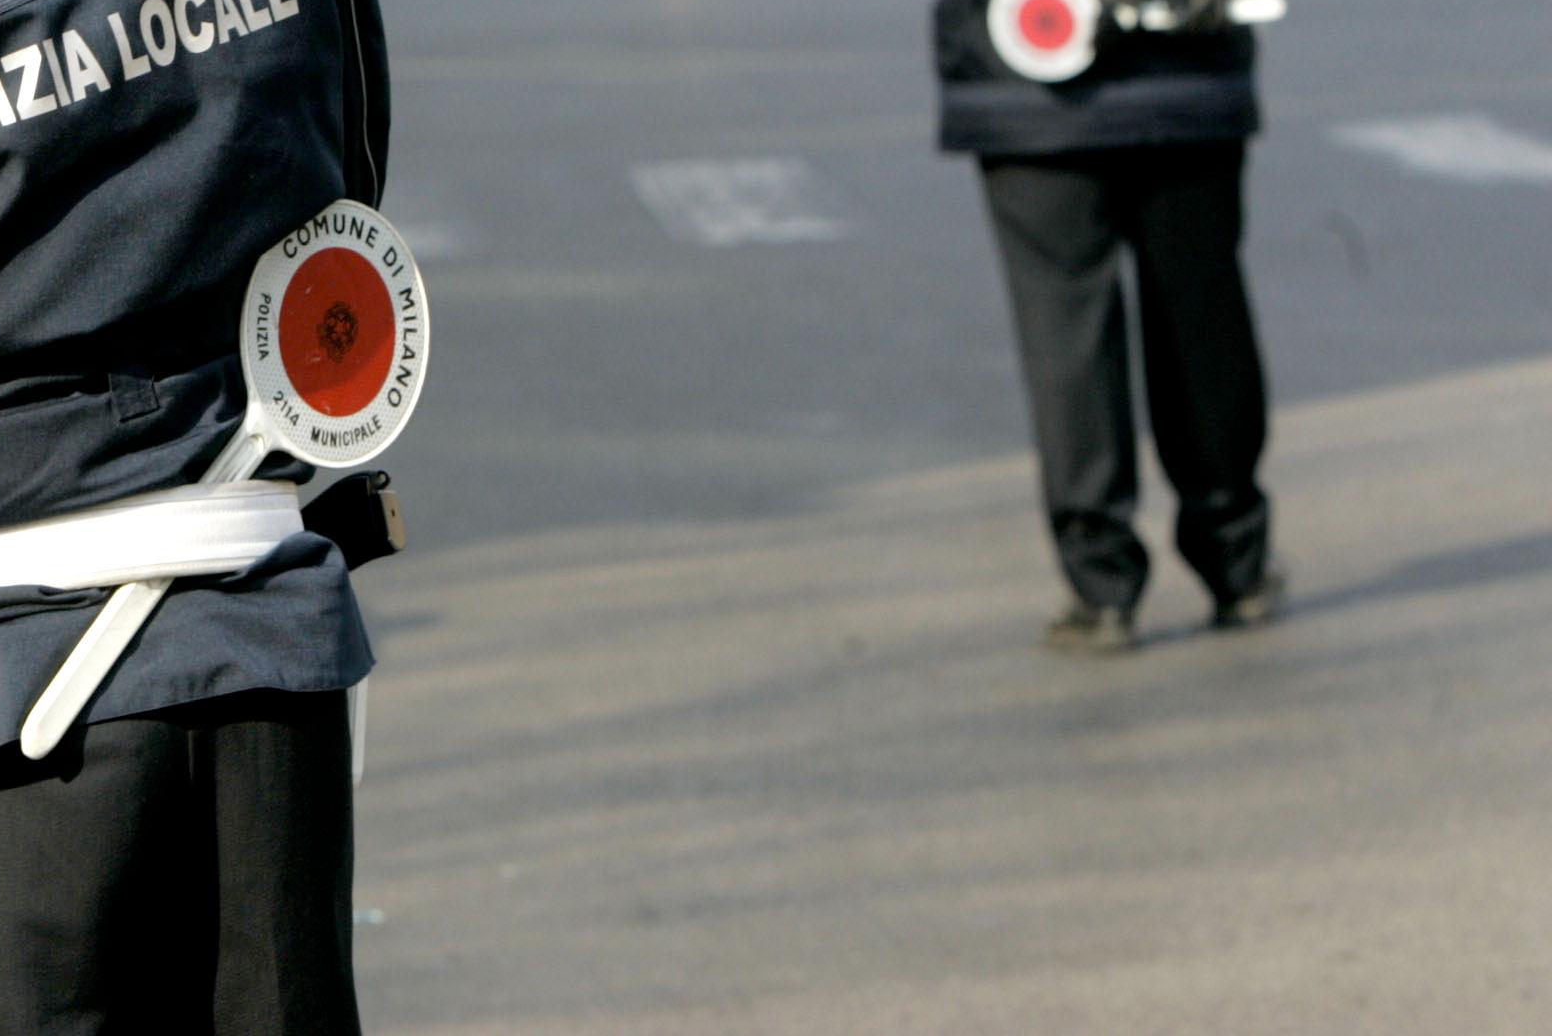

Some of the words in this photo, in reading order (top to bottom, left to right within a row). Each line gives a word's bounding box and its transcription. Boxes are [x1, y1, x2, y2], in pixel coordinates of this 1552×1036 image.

[282, 214, 378, 259] COMUNE
[383, 246, 404, 277] DI
[257, 293, 272, 361] POLIZIA
[387, 287, 419, 408] MILANO
[273, 391, 300, 426] 2114
[310, 414, 382, 447] MUNICIPALE
